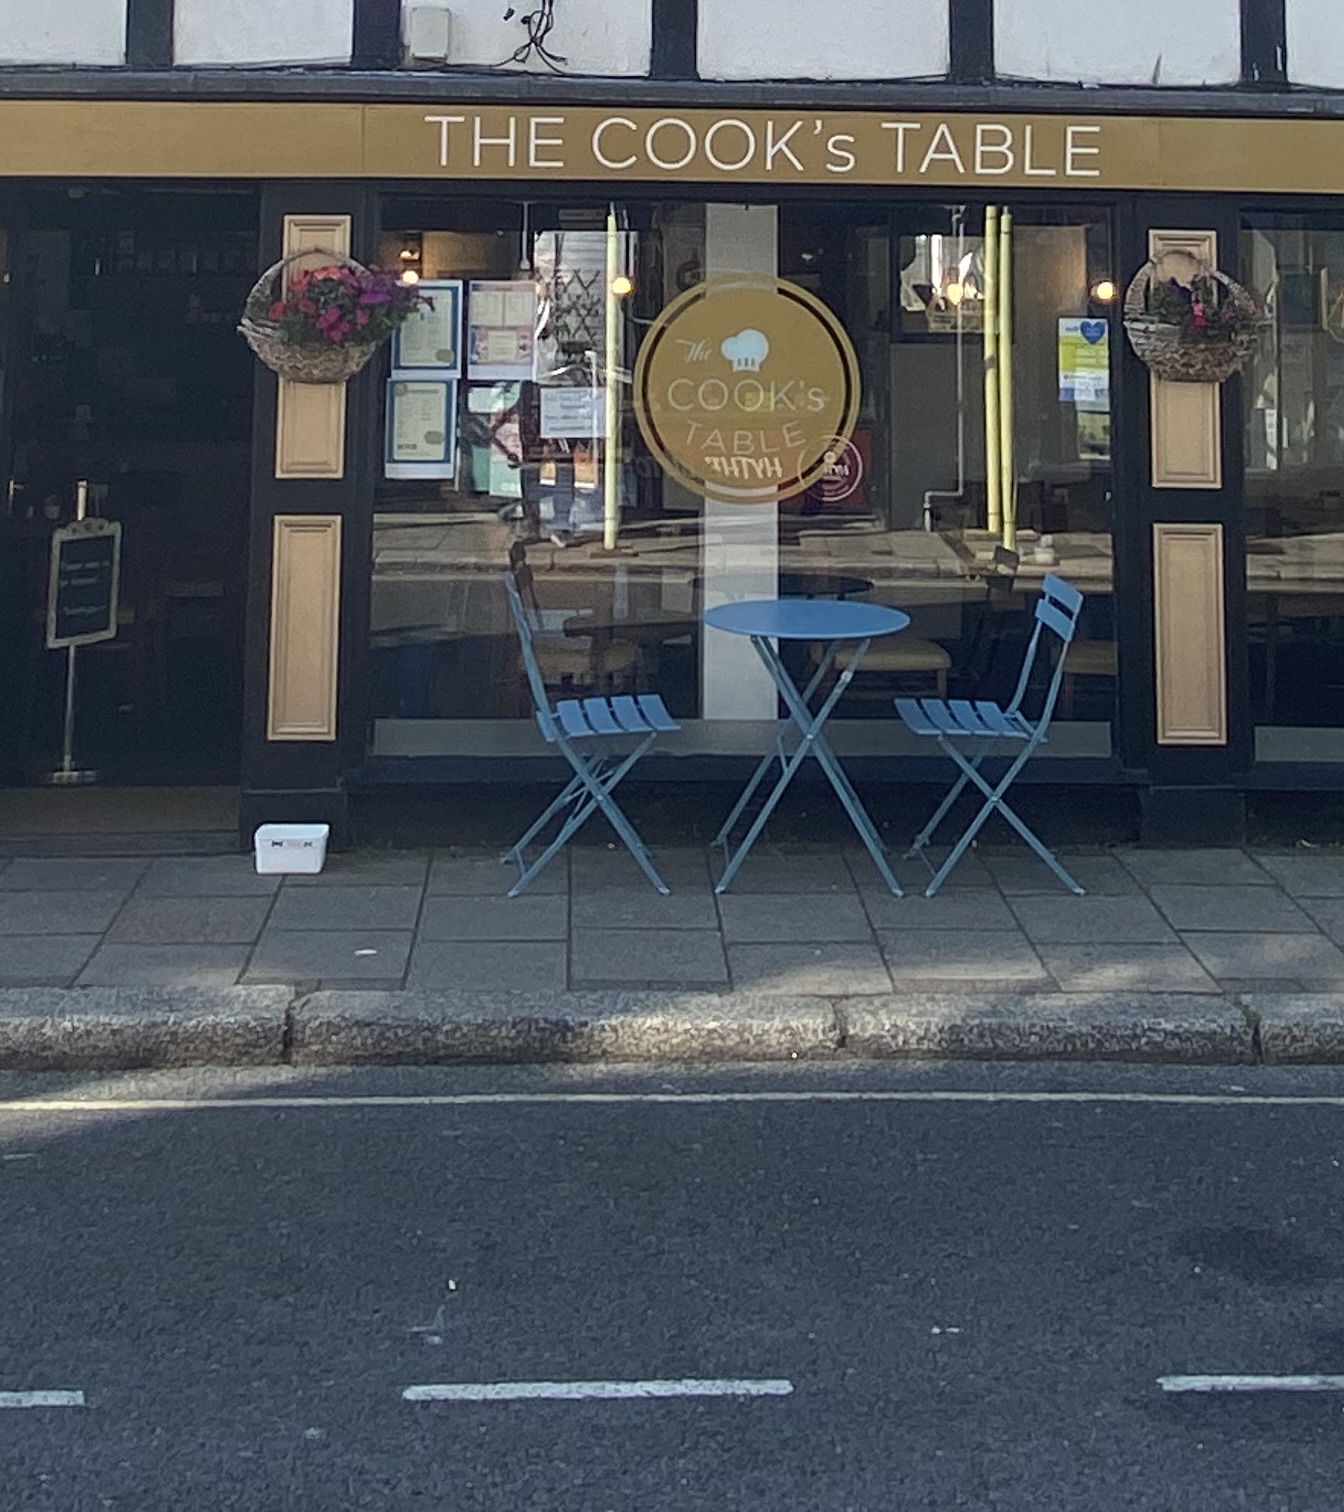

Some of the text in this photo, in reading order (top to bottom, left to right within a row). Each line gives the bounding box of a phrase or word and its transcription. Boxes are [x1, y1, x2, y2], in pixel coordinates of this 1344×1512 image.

[424, 115, 1101, 178] THE COOK's TABLE
[667, 378, 826, 413] COOK's
[685, 420, 807, 456] TABLE
